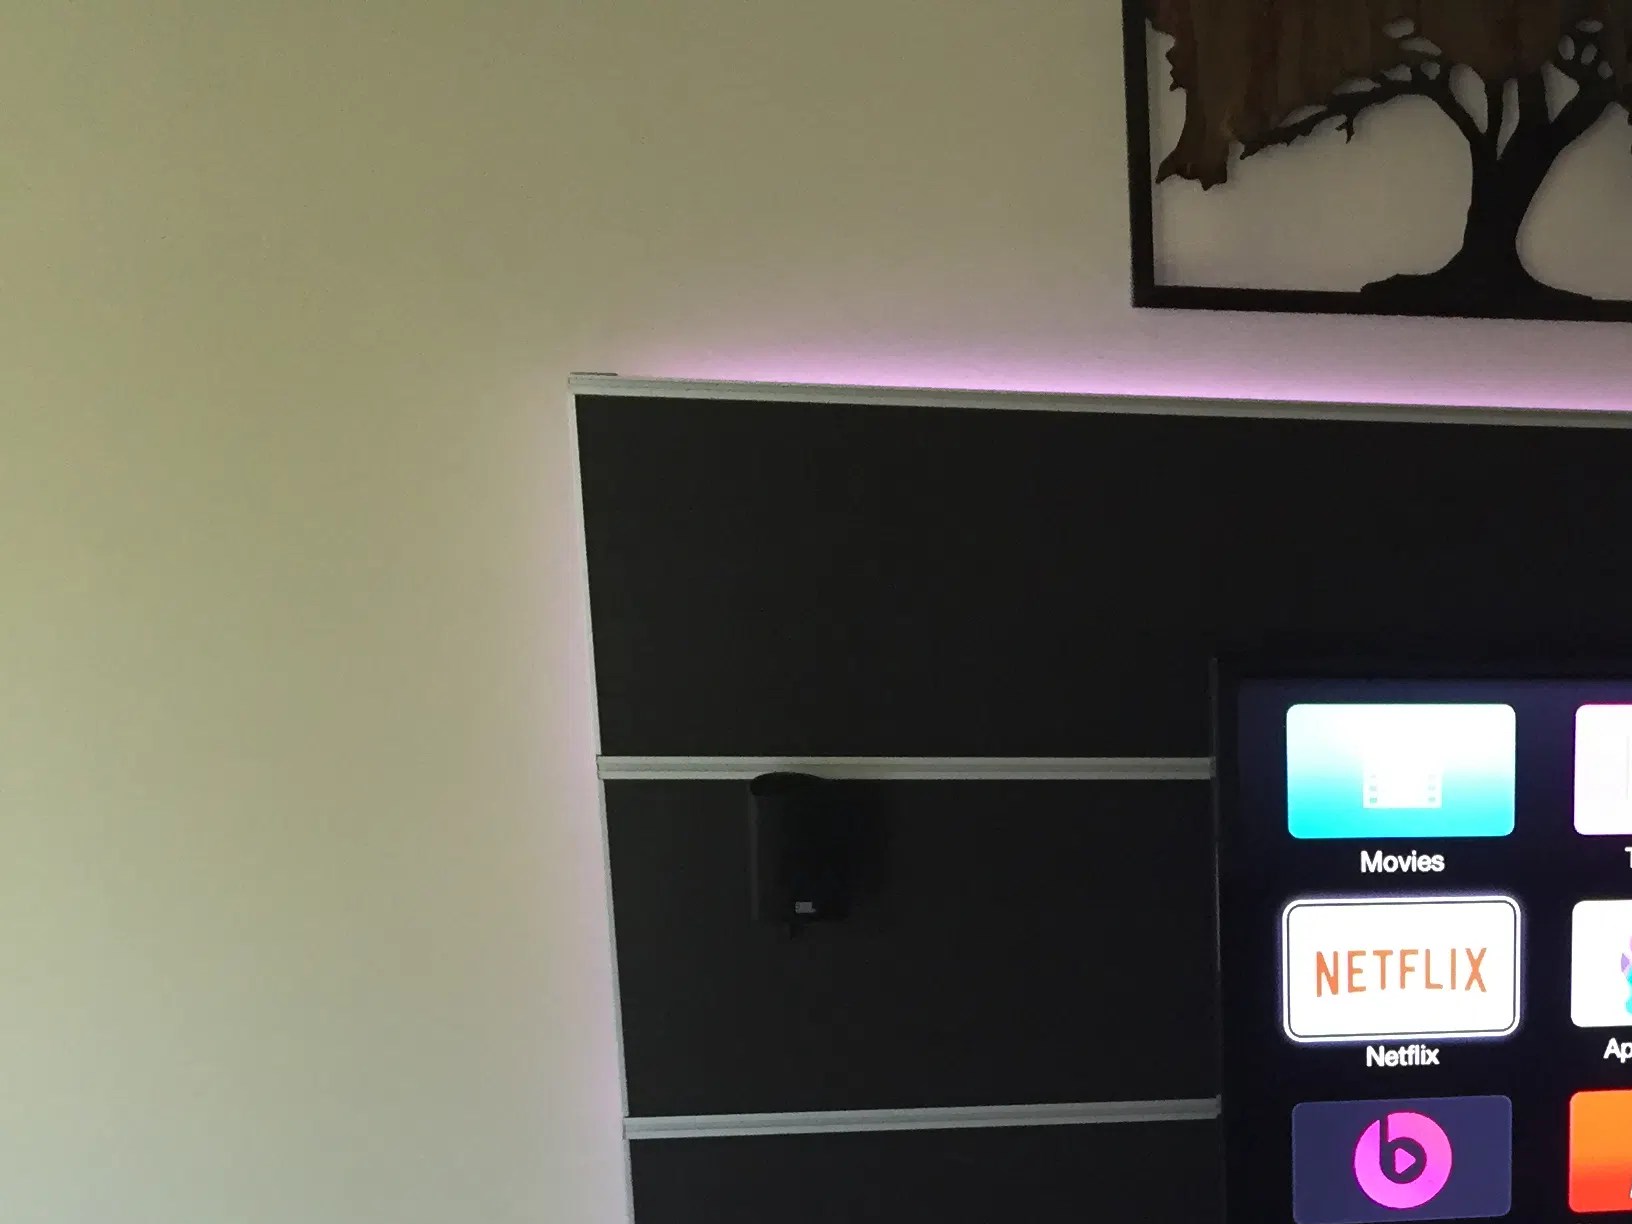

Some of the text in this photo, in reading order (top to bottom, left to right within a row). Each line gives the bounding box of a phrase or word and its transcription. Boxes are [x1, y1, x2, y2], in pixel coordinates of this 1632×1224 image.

[1360, 849, 1446, 873] Movies
[1316, 947, 1488, 997] NETFLIX
[1365, 1043, 1441, 1068] Netflix
